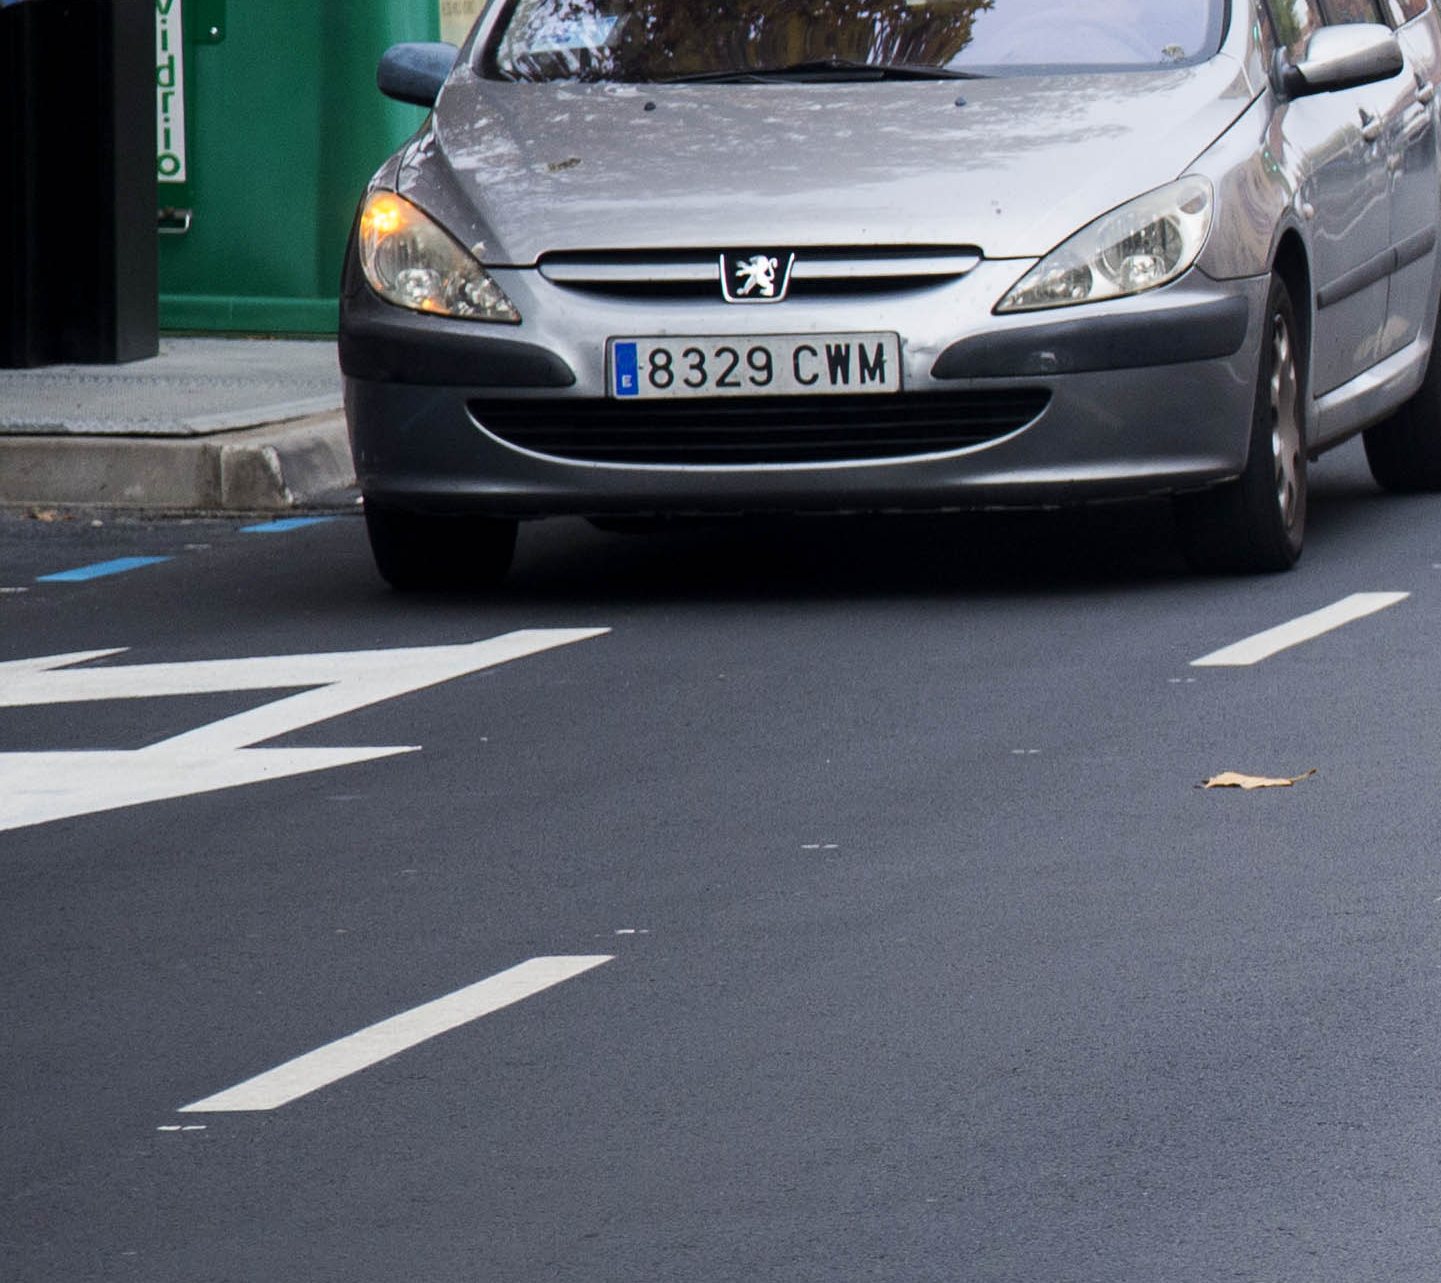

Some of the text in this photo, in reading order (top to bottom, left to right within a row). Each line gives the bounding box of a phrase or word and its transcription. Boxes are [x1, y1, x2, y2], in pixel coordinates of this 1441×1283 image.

[621, 343, 887, 389] E 8329 CWM
